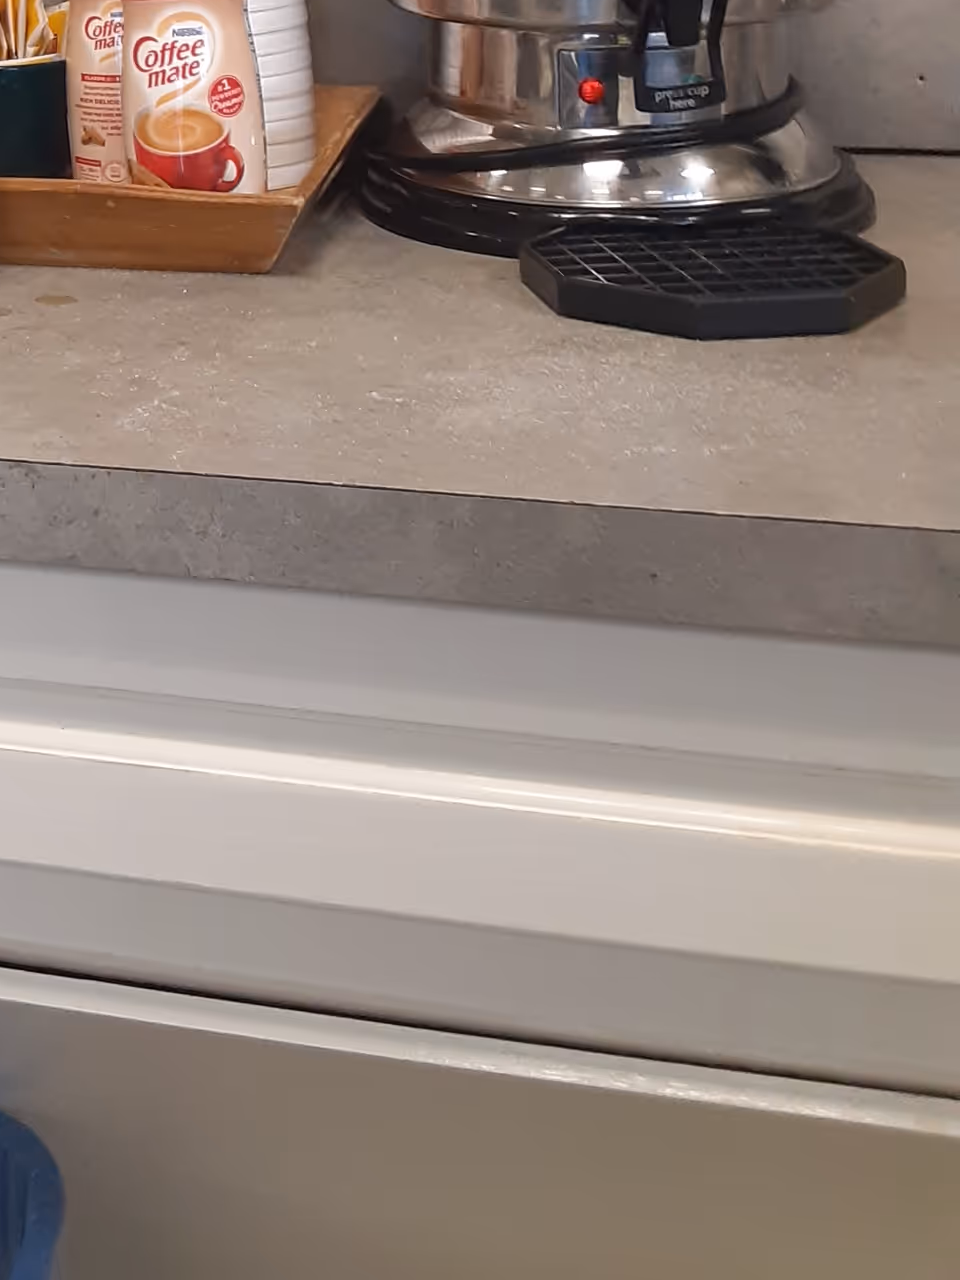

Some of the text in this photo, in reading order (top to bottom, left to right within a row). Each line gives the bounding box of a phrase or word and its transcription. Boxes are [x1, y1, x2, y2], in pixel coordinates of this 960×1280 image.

[133, 35, 206, 73] Coffee
[147, 58, 201, 89] mate
[686, 85, 710, 98] cup
[669, 97, 697, 111] here
